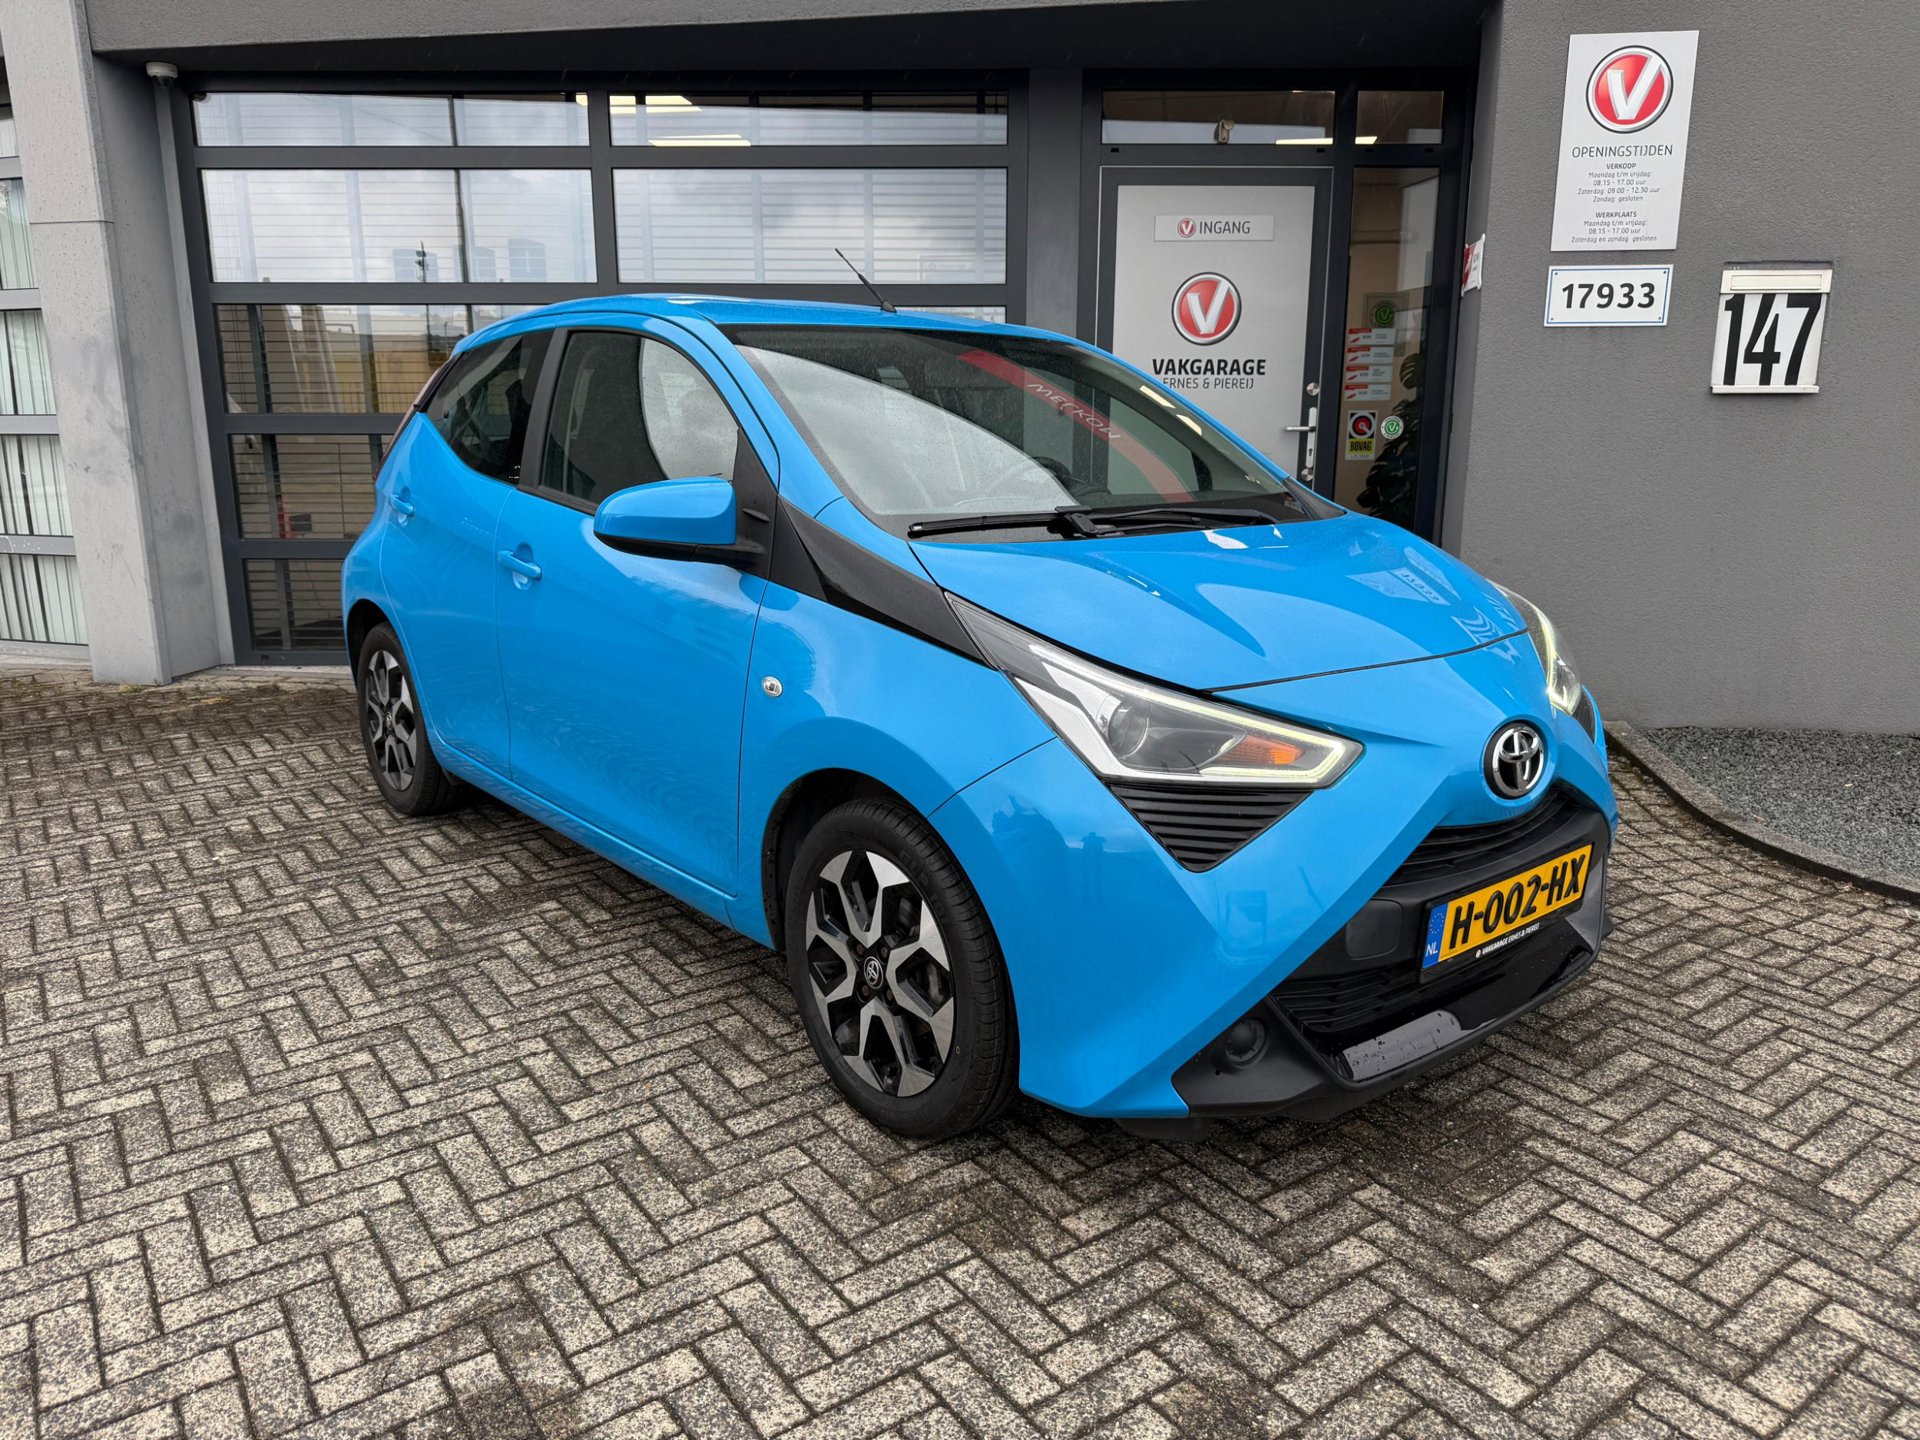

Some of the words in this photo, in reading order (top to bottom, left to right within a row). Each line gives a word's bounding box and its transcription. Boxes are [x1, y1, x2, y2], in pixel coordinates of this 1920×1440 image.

[1572, 144, 1674, 158] OPENINGSTIJDEN
[1606, 162, 1637, 170] VERKOOP
[1199, 221, 1251, 234] INGANG
[1562, 282, 1655, 309] 17933
[1723, 293, 1822, 386] 147
[1152, 358, 1267, 376] VAKGARAGE
[1202, 378, 1210, 389] &
[1214, 377, 1254, 389] PIEREIJ
[1349, 440, 1372, 452] BOVAG
[1449, 853, 1586, 950] H-002-HX
[1425, 941, 1439, 957] NL
